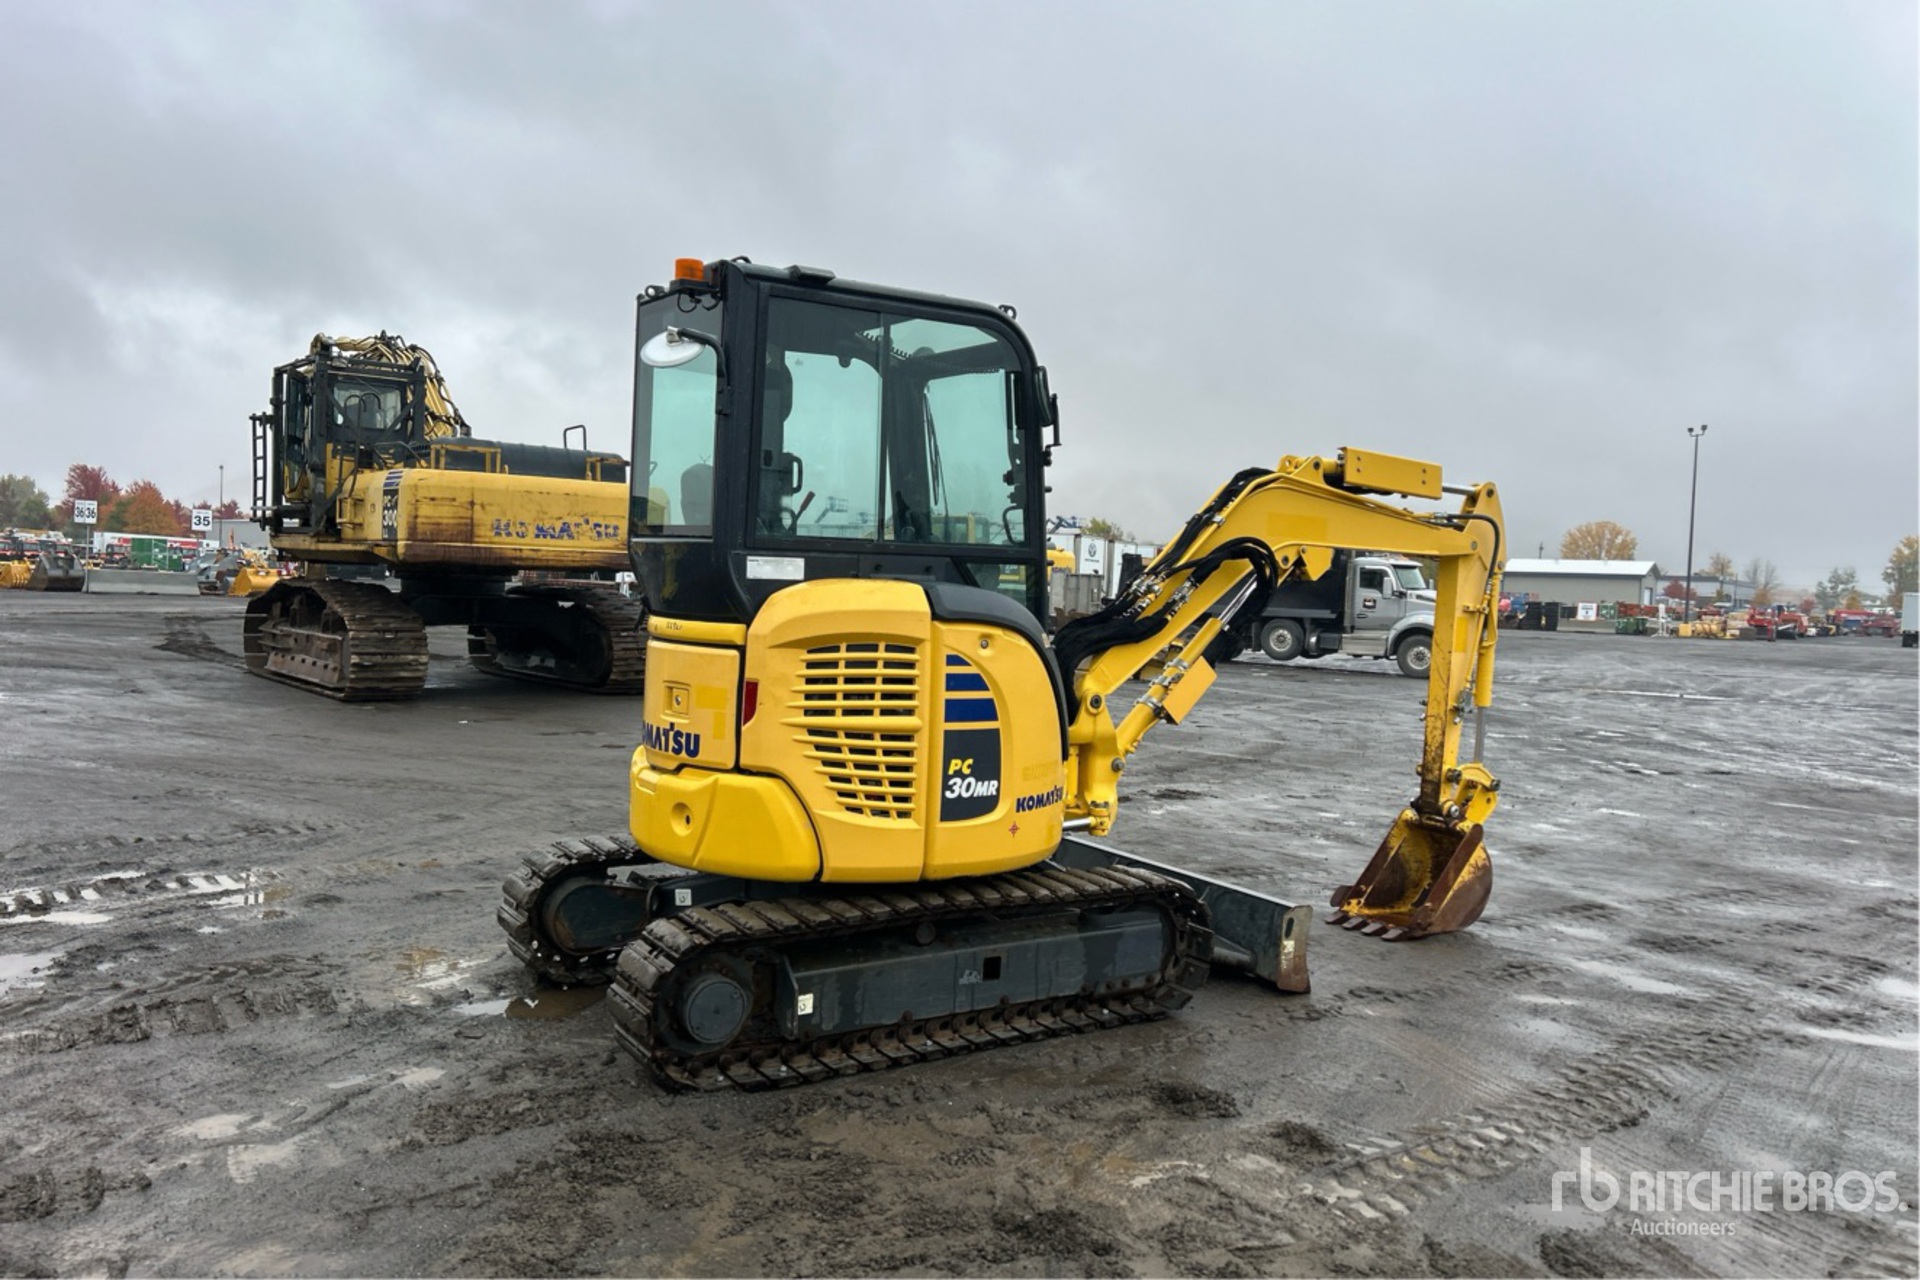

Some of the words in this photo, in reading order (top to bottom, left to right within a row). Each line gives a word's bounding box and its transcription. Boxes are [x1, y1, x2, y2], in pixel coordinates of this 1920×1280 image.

[75, 506, 84, 518] 36
[85, 507, 96, 519] 36
[193, 515, 210, 527] 35
[947, 757, 974, 776] PC
[944, 777, 999, 799] 30MR
